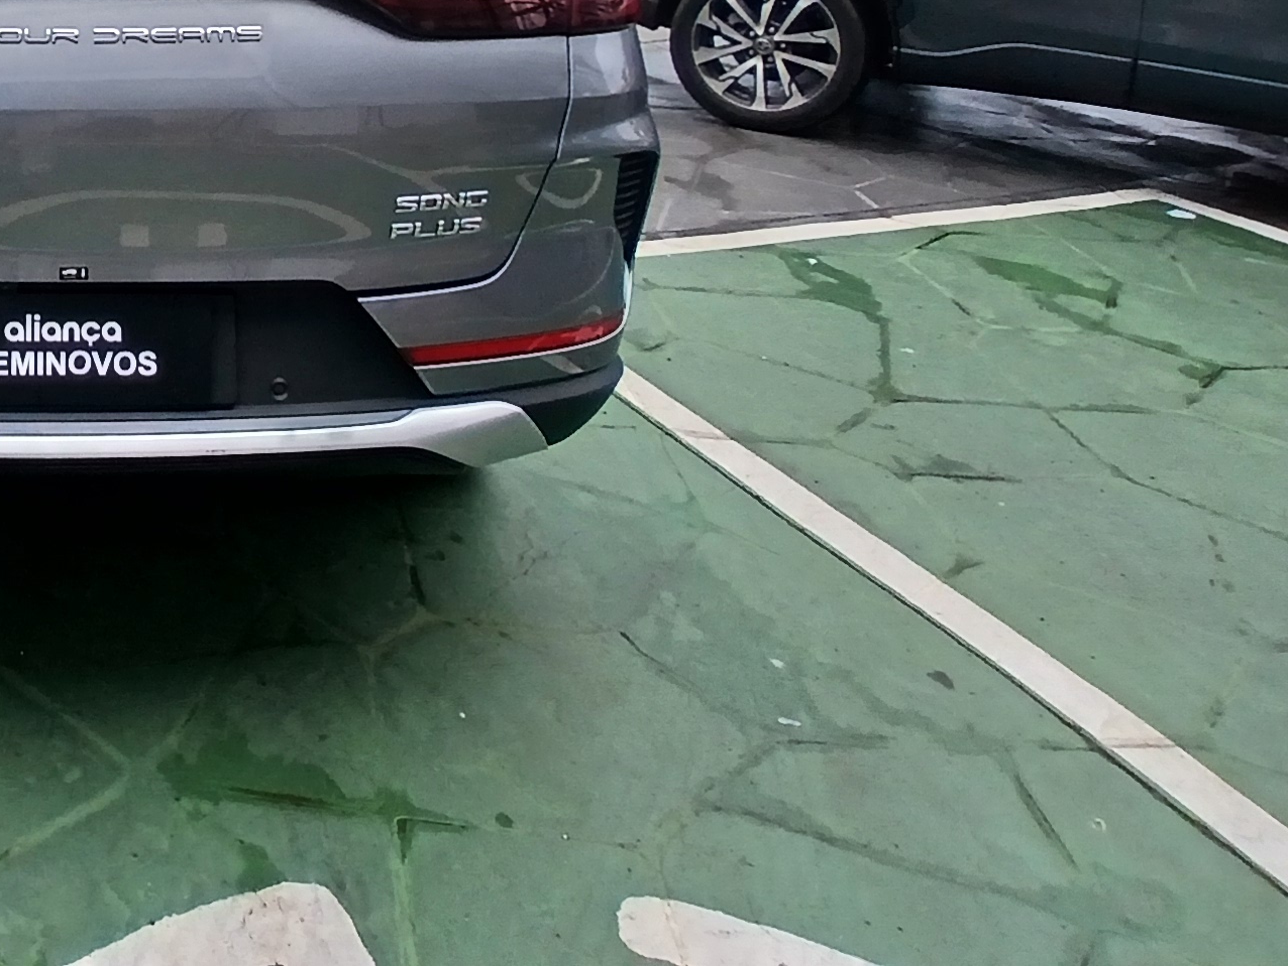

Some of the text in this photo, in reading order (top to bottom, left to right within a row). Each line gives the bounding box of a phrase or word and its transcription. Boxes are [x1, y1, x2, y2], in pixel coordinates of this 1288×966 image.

[92, 24, 263, 45] DREAMS
[394, 189, 489, 214] SONG
[389, 216, 483, 240] PLUS
[3, 313, 123, 347] aliança
